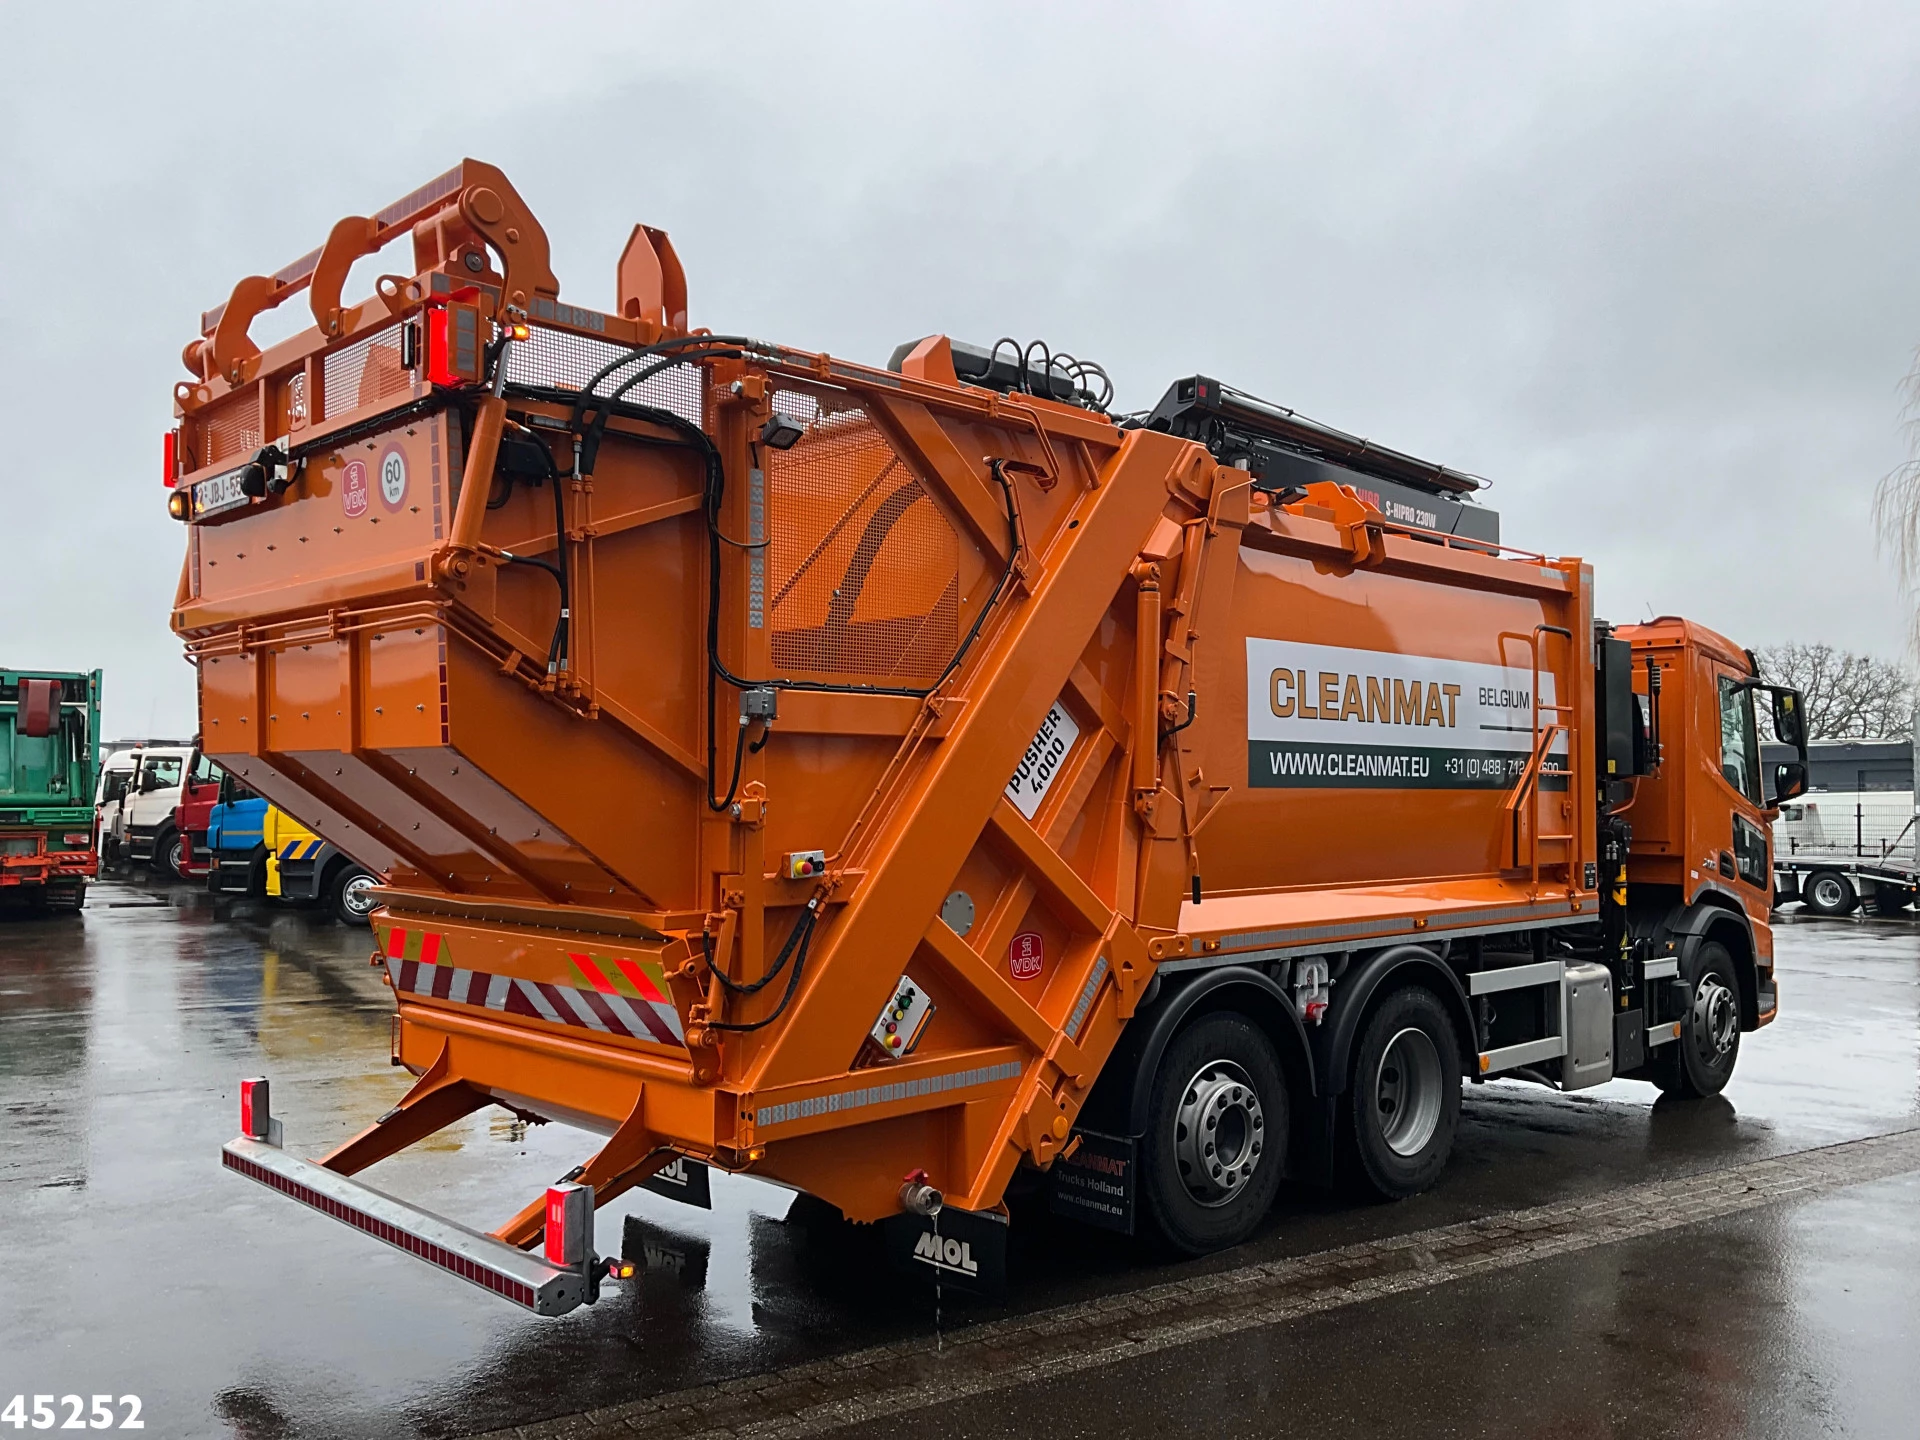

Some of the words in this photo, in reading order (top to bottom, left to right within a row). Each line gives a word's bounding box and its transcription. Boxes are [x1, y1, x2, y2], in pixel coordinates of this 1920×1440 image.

[385, 459, 401, 484] 60
[344, 488, 367, 510] VDK
[389, 486, 400, 497] km
[1385, 500, 1415, 523] S-HIPRO
[1416, 509, 1437, 528] 230W
[1269, 667, 1461, 728] CLEANMAT
[1479, 686, 1530, 710] BELGIUM
[1008, 708, 1062, 795] PUSHER
[1270, 751, 1430, 778] WWW.CLEANMAT.EU
[1444, 757, 1464, 774] +31
[1466, 758, 1480, 778] (0)
[1030, 737, 1065, 794] 4000
[1012, 956, 1041, 973] VDK
[658, 1158, 688, 1181] OL
[1058, 1170, 1085, 1187] Trucks
[1087, 1178, 1124, 1197] Holland
[1057, 1191, 1123, 1216] www.cleanmat.eu
[914, 1231, 978, 1272] MOL
